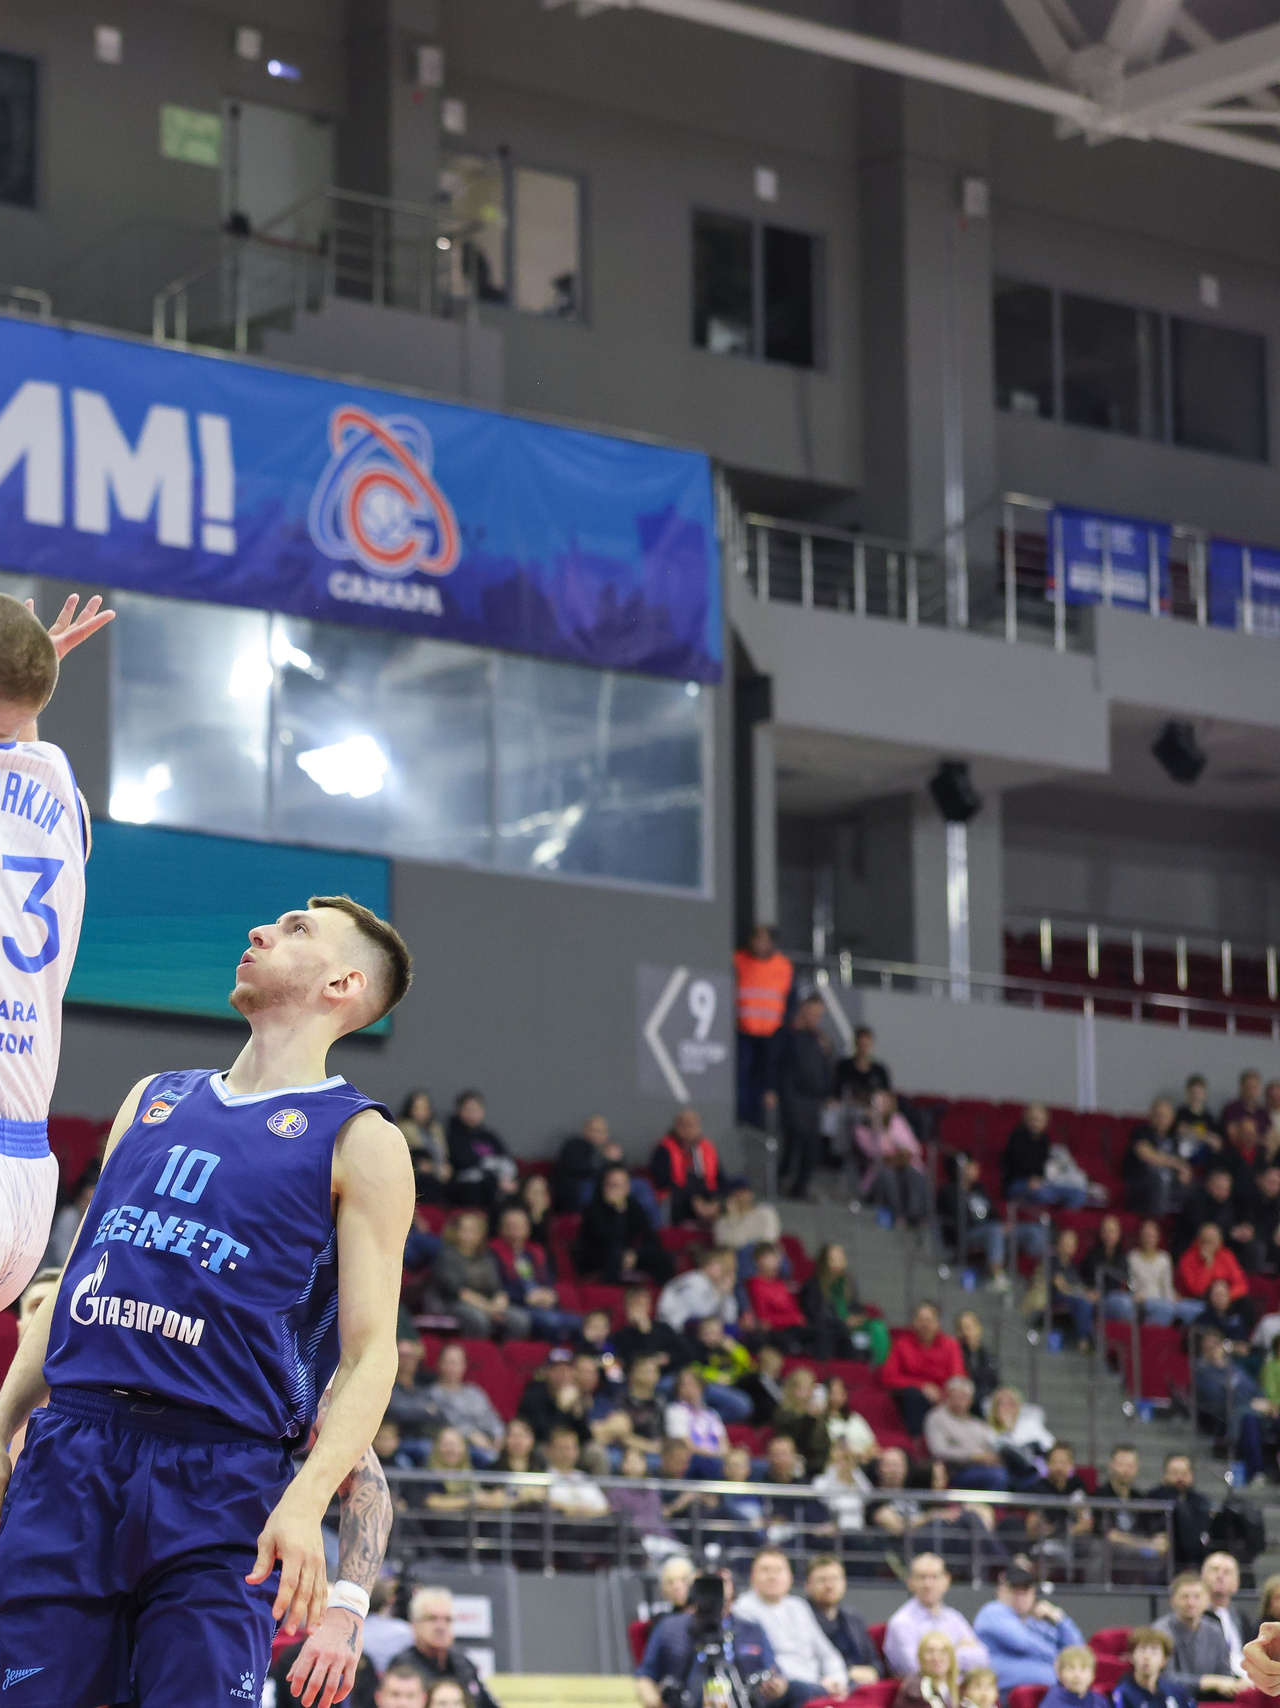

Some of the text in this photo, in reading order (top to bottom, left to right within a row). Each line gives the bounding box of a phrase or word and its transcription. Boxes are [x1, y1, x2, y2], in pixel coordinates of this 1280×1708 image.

[688, 979, 717, 1041] 9
[153, 1144, 221, 1204] 10
[91, 1205, 250, 1274] ZENIT
[98, 1296, 206, 1347] ГАЗПРОМ
